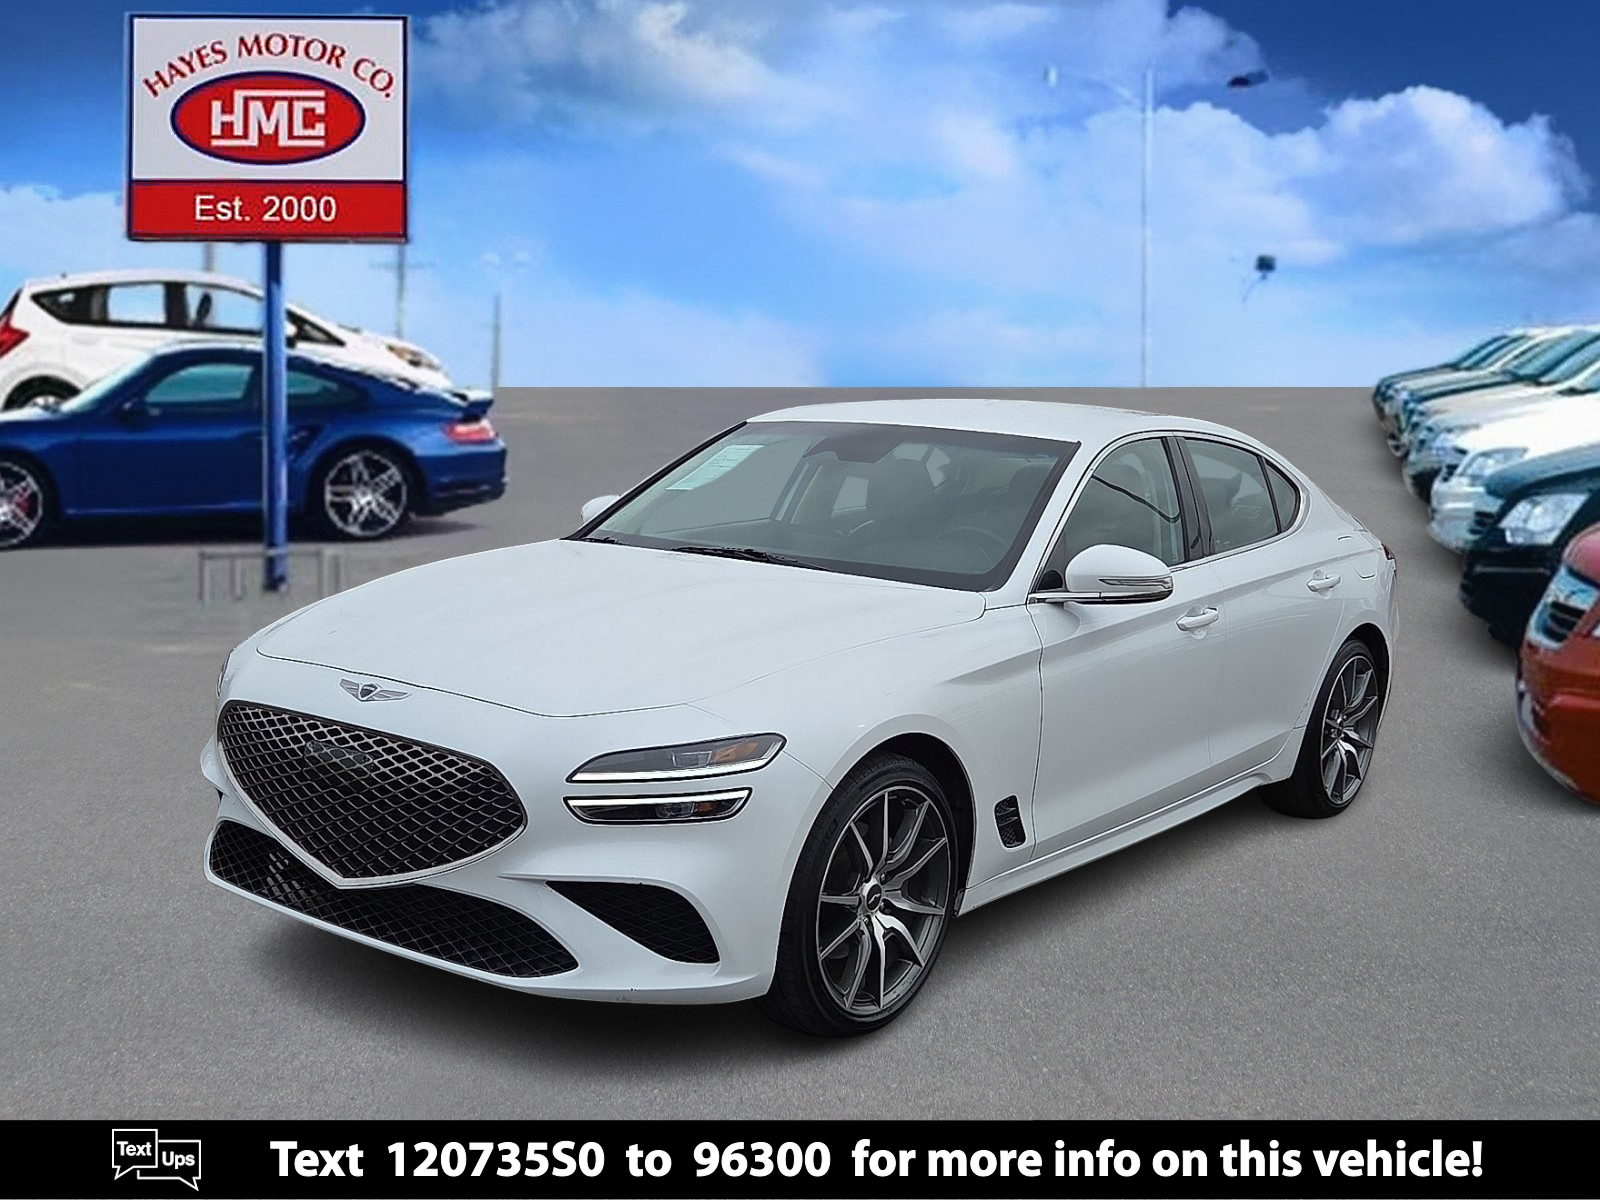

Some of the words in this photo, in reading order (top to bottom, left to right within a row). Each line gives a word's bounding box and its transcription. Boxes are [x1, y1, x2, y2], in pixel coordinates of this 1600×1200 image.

[142, 40, 227, 97] HAYES
[237, 32, 346, 69] MOTOR
[352, 57, 395, 98] CO.
[210, 88, 326, 147] HMC
[194, 195, 251, 222] Est.
[261, 195, 337, 222] 2000
